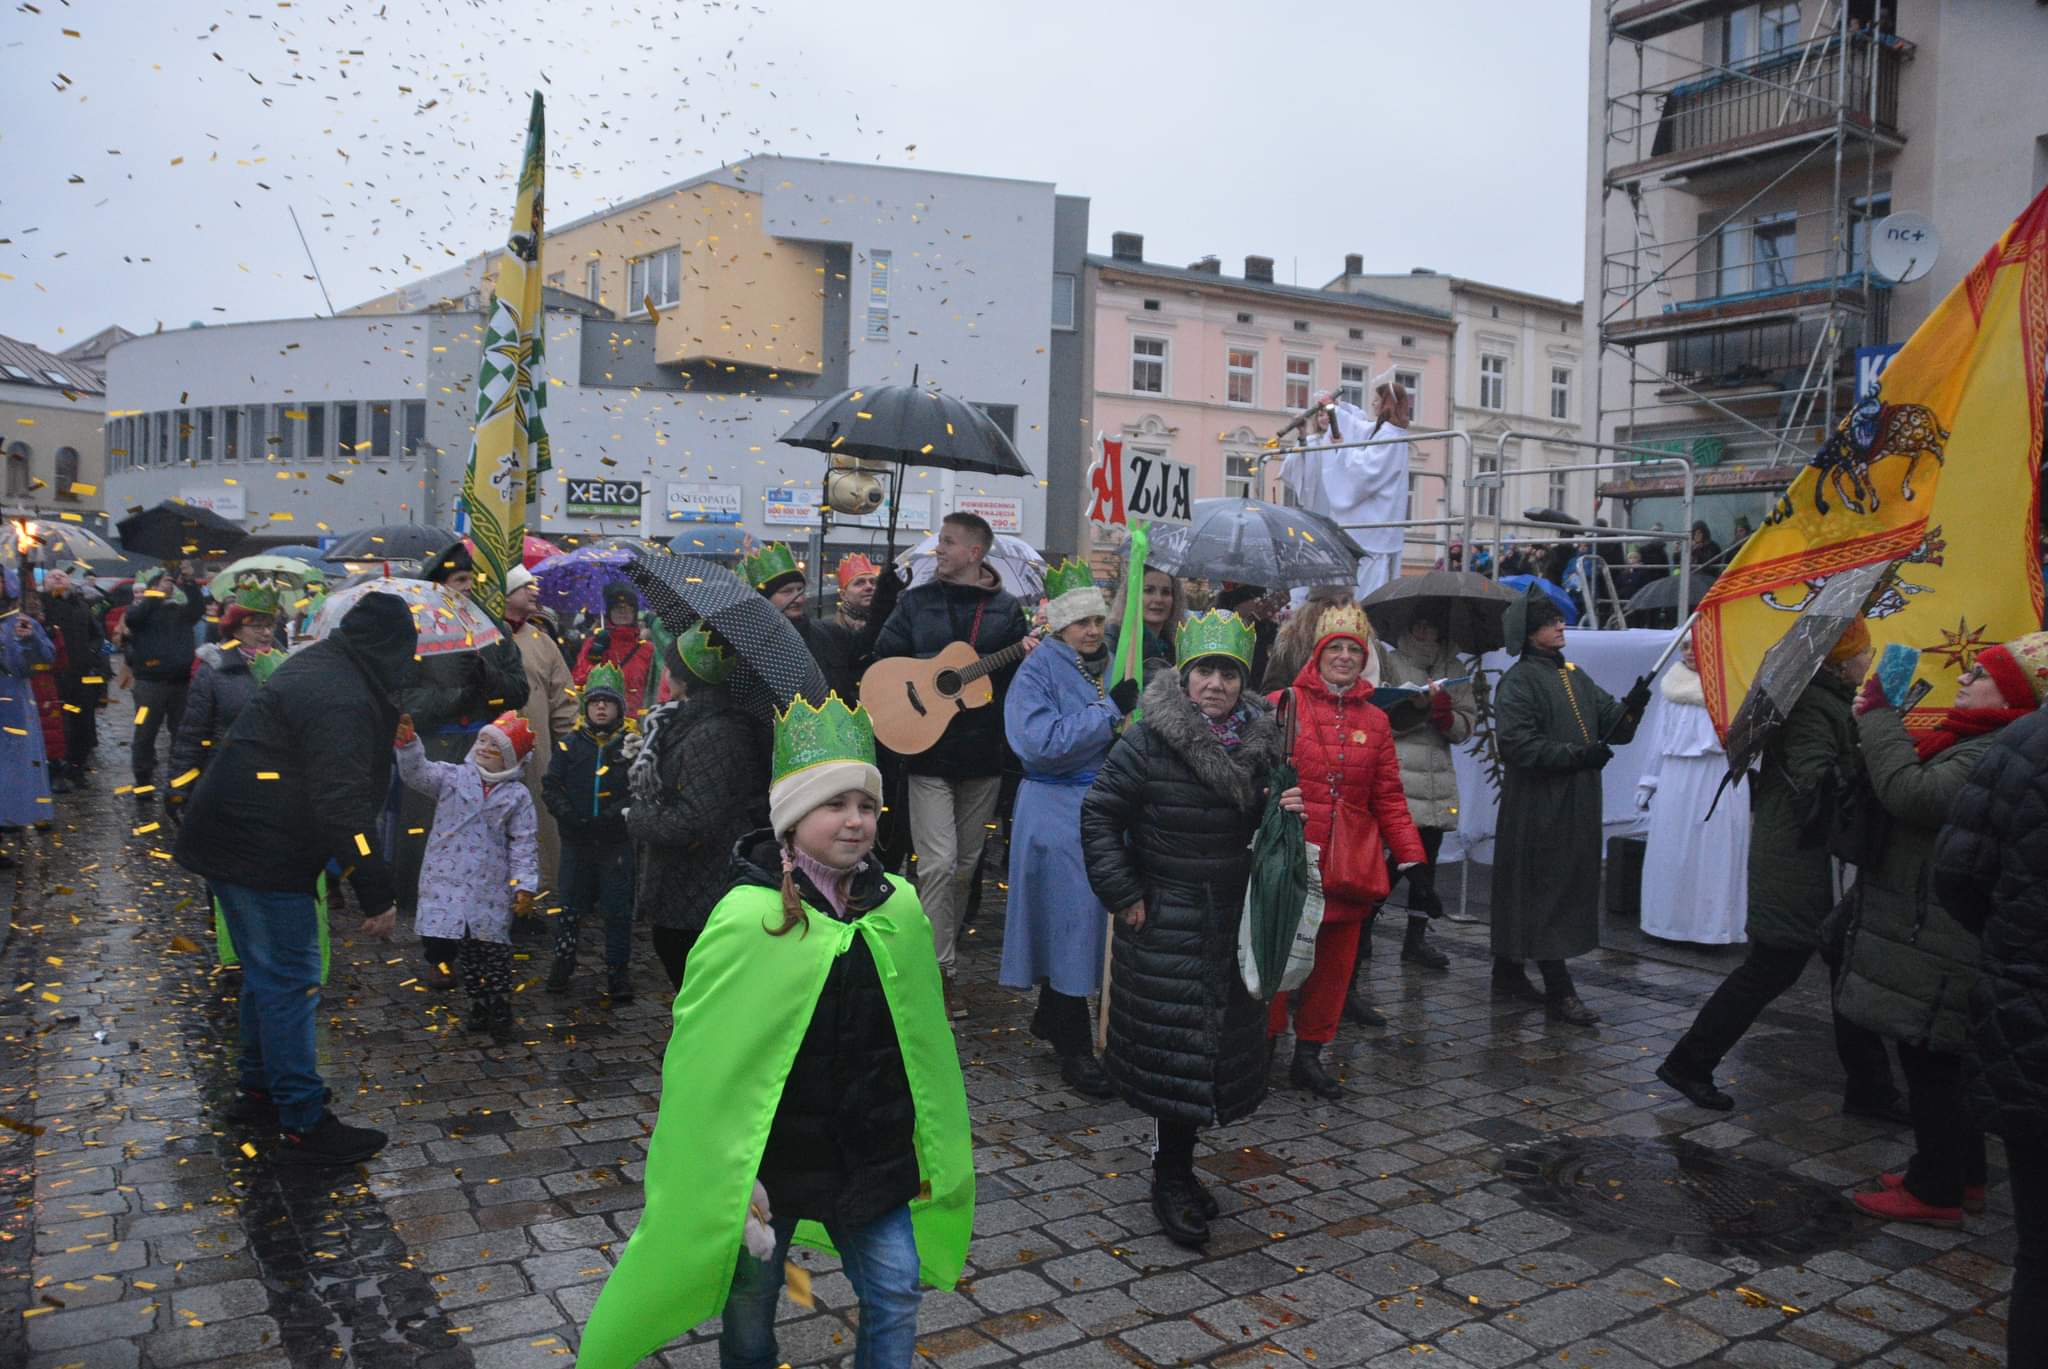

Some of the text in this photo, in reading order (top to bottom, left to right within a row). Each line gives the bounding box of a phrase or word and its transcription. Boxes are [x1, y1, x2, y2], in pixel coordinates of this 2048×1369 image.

[1887, 226, 1925, 242] nc+
[1091, 440, 1192, 526] AZJA
[570, 482, 639, 503] XERO
[670, 492, 737, 505] OSTEOPATIA
[991, 519, 1008, 527] 290
